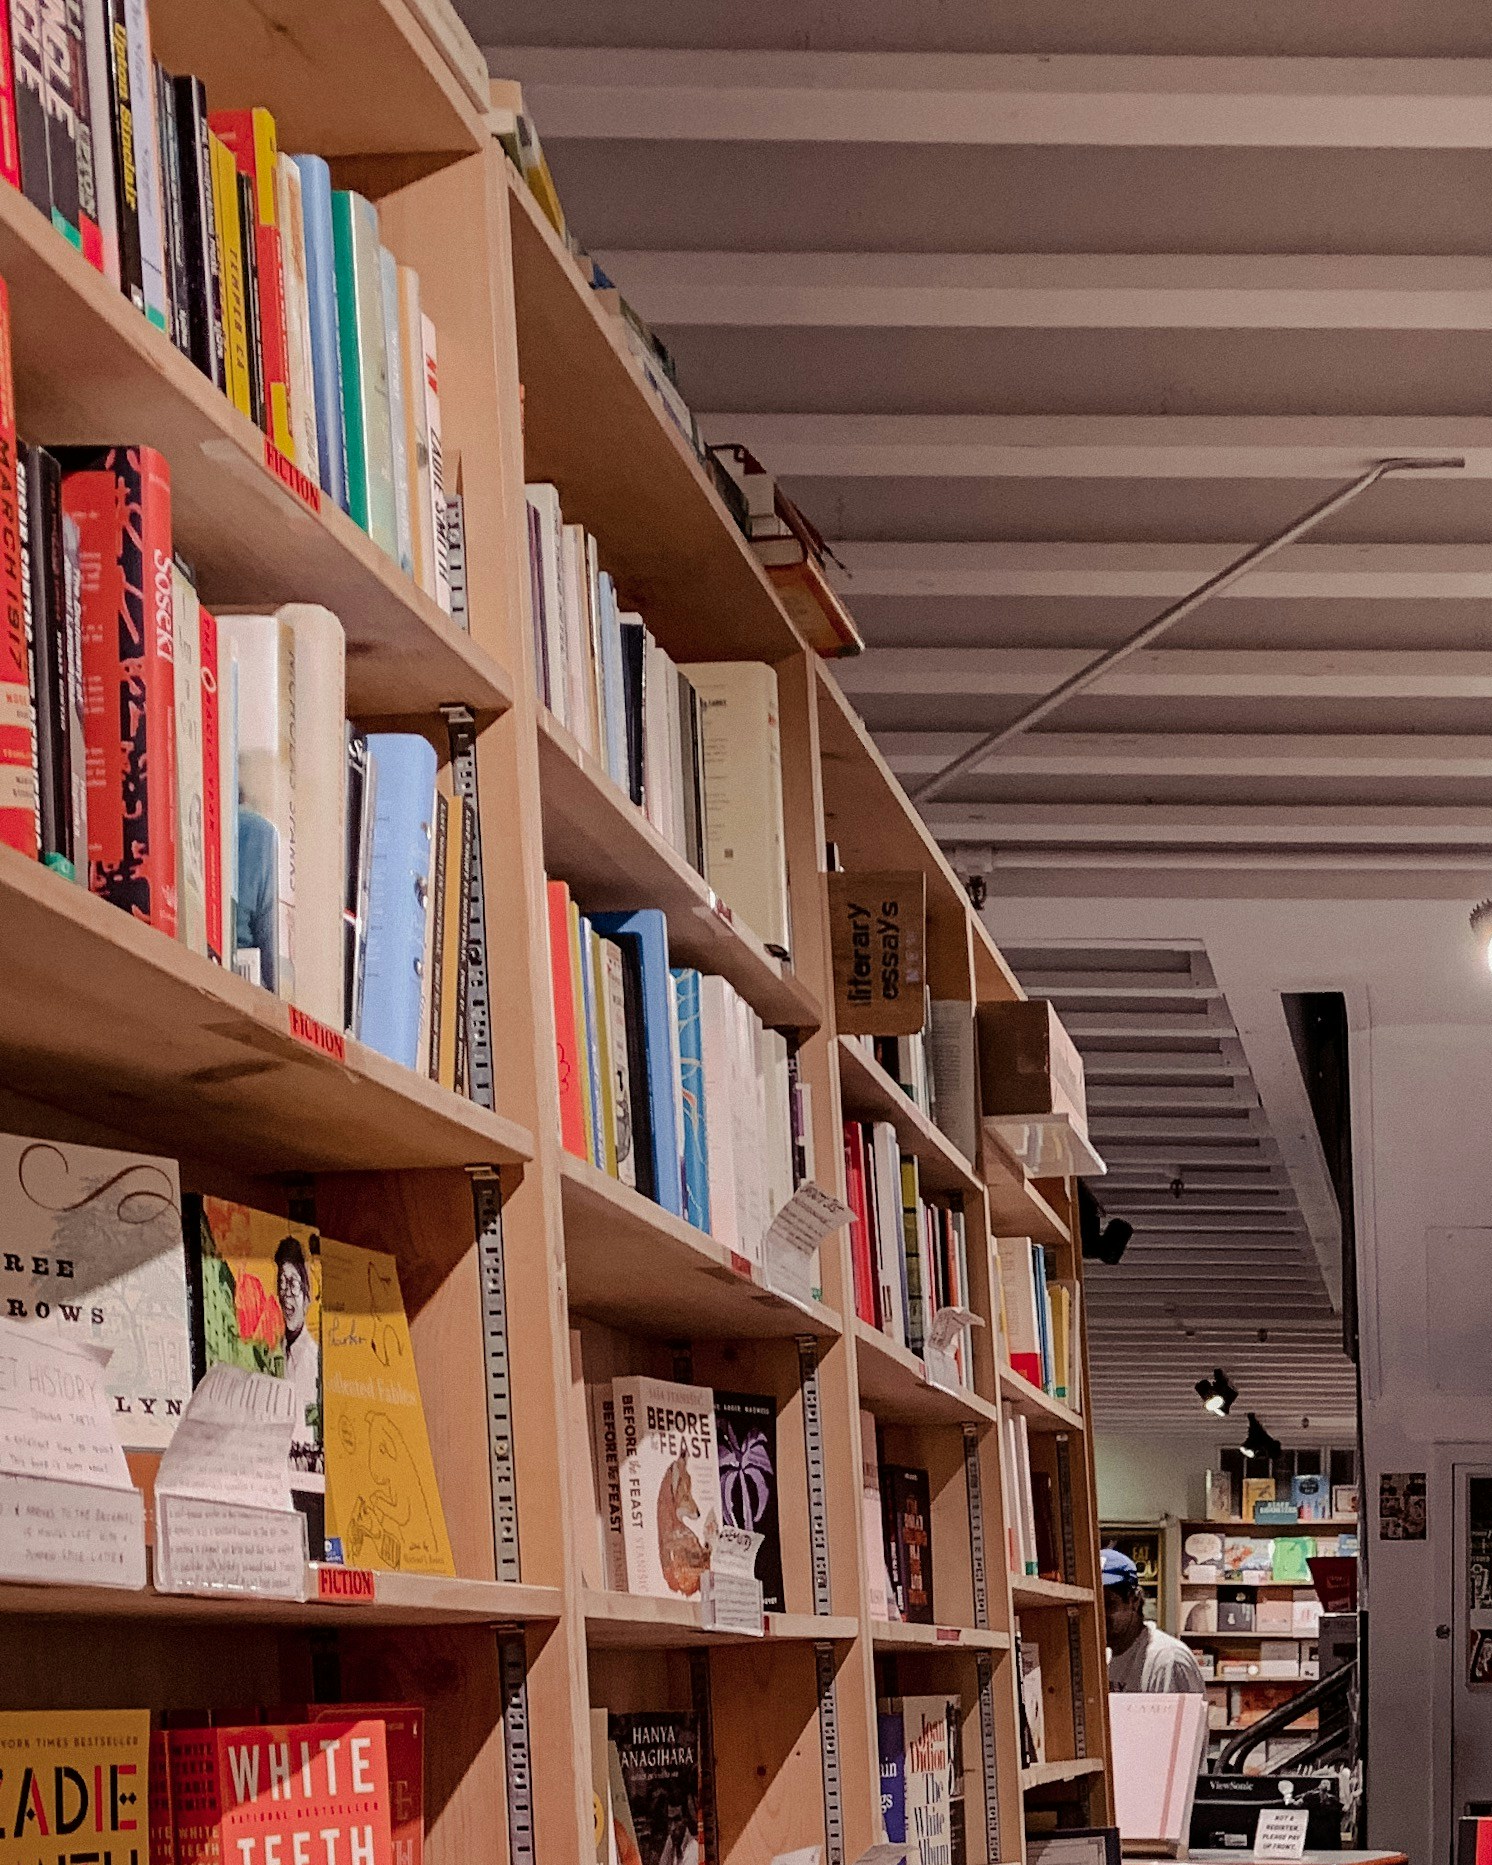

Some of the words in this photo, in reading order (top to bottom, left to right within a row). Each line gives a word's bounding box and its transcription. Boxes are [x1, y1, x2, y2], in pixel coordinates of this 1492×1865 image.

[266, 443, 320, 512] FICTION
[0, 437, 19, 583] MARCH
[435, 500, 450, 580] SMITH
[6, 588, 22, 668] 1917
[847, 903, 871, 1006] literary
[881, 900, 900, 1001] essays
[290, 1006, 344, 1058] FICTION
[602, 1401, 618, 1463] BEFORE
[622, 1394, 638, 1457] BEFORE
[647, 1405, 711, 1436] BEFORE
[660, 1431, 711, 1459] FEAST
[608, 1484, 622, 1534] FEAST
[629, 1478, 644, 1529] FEAST
[319, 1569, 375, 1595] FICTION
[36, 1737, 69, 1748] TIMES
[73, 1735, 139, 1747] BESTSELLER
[632, 1725, 675, 1744] HANYA
[920, 1713, 946, 1749] Joan
[227, 1736, 375, 1804] WHITE
[621, 1748, 694, 1769] ANAGIHARA
[910, 1741, 949, 1773] Didion
[0, 1764, 138, 1839] ADIE
[922, 1773, 944, 1804] The
[1208, 1781, 1255, 1792] ViewSonic
[914, 1806, 946, 1838] White
